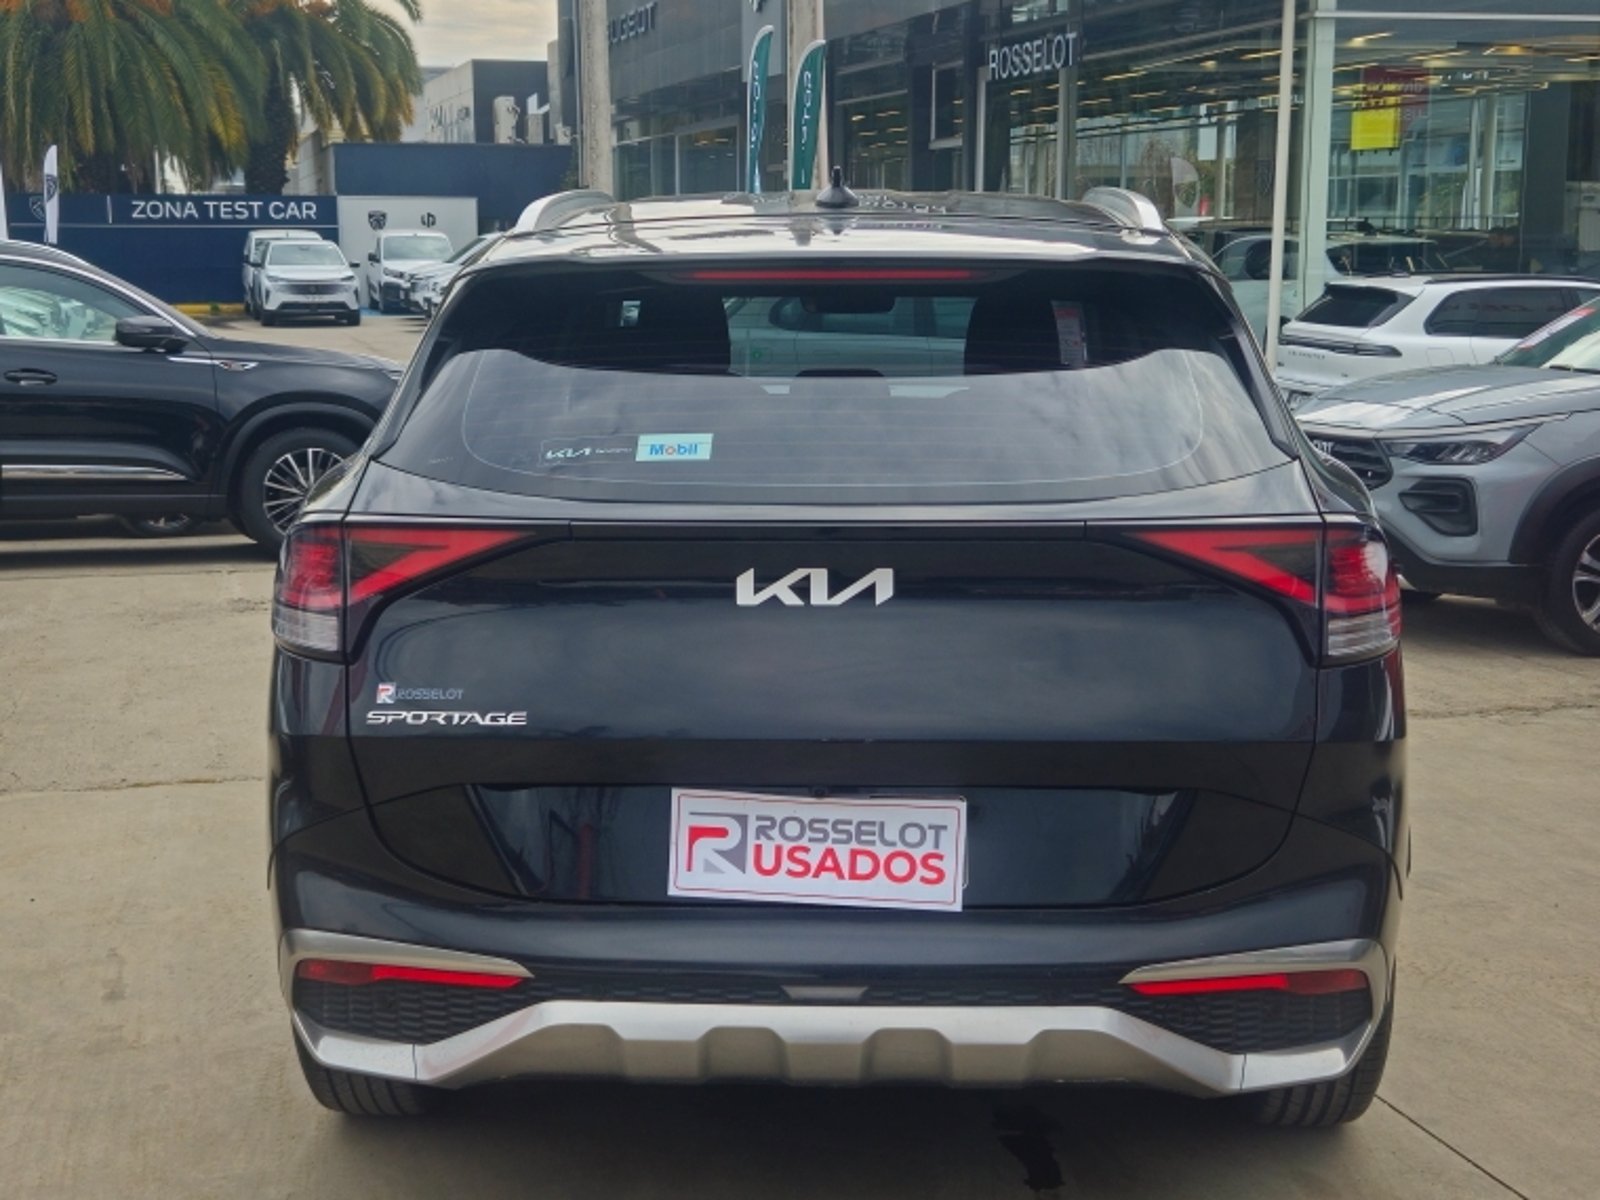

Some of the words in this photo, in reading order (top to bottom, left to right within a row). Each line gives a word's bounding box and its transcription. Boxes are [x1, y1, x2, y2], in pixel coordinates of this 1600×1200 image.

[609, 1, 658, 46] UGEOT
[989, 32, 1077, 80] ROSSELOT
[131, 201, 199, 219] ZONA
[203, 201, 263, 219] TEST
[268, 201, 317, 220] CAR
[650, 443, 698, 456] Mobil
[736, 567, 894, 607] KIA
[366, 710, 528, 726] SPORTAGE
[754, 814, 948, 850] ROSSELOT
[752, 843, 947, 886] USADOS
